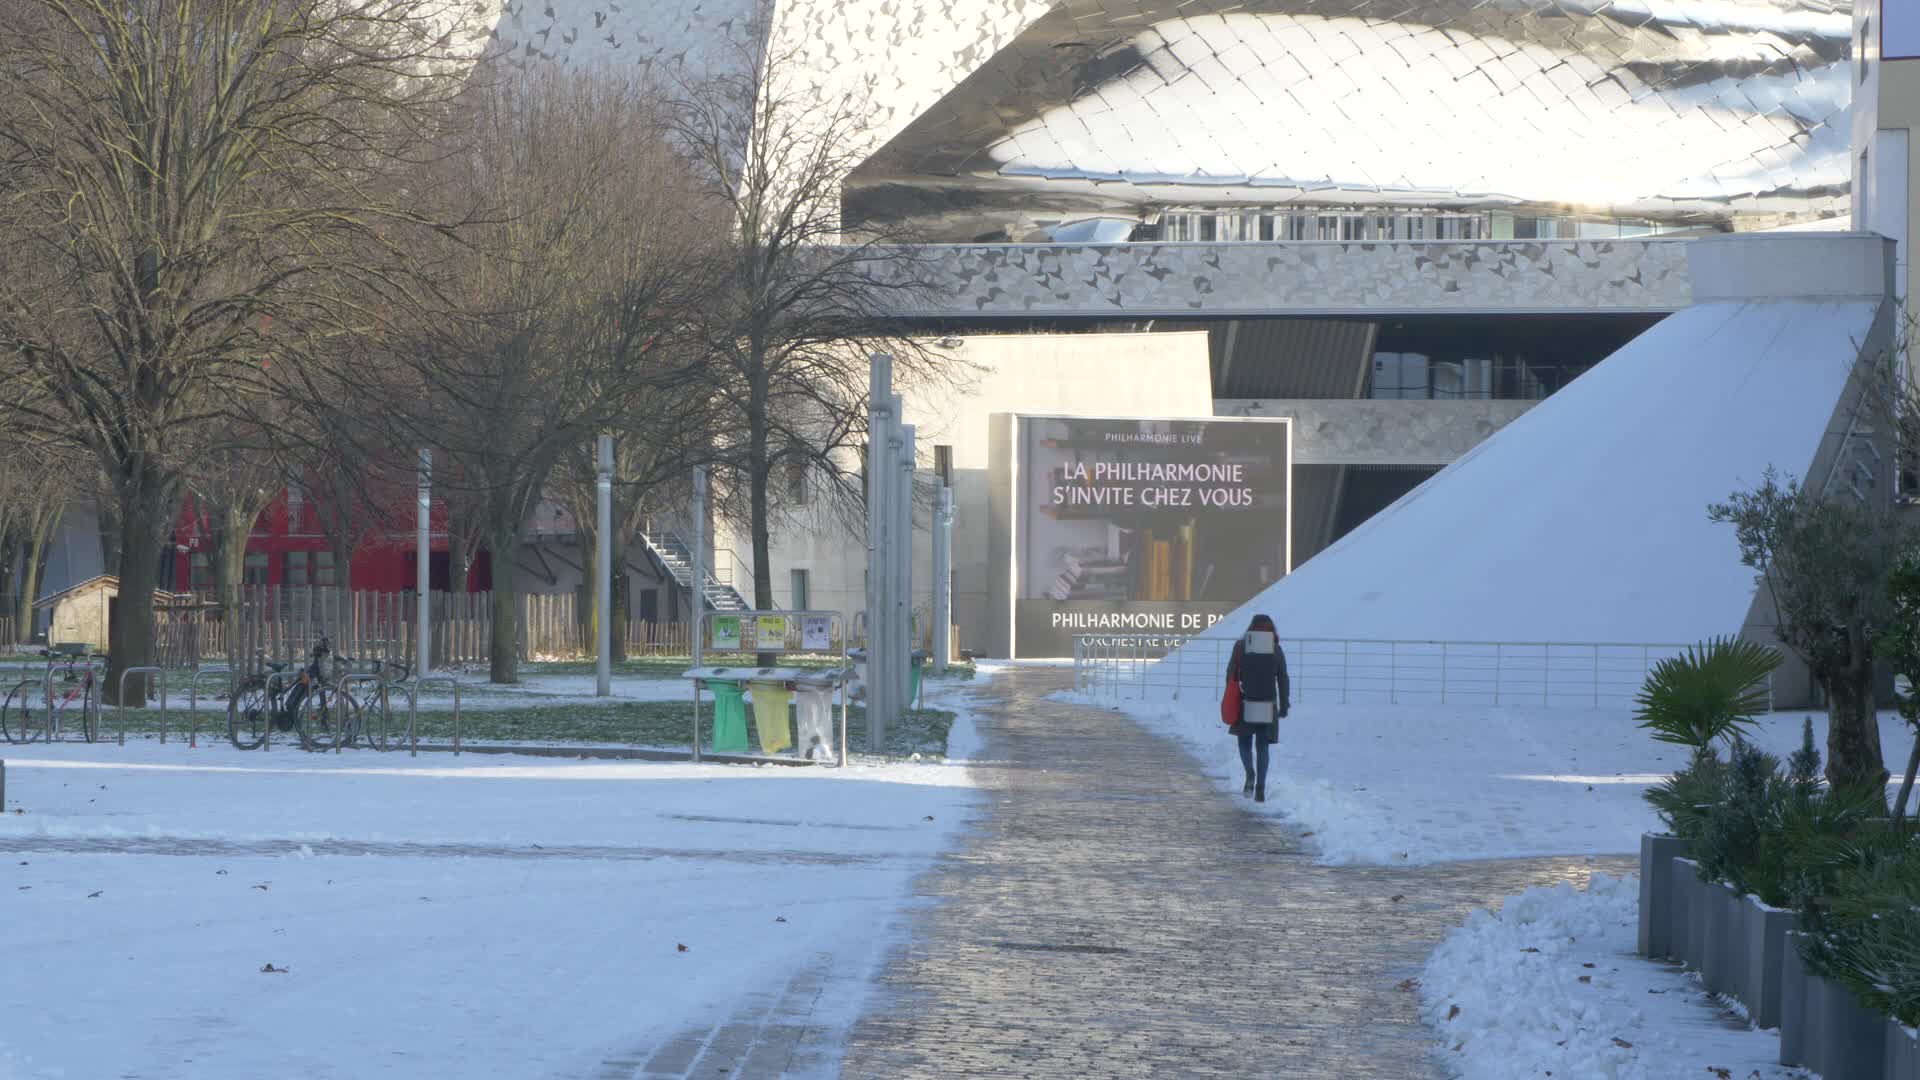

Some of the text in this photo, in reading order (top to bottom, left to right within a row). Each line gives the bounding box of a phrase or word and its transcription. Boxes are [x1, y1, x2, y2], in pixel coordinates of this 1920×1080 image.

[1105, 433, 1202, 444] PHILHARMONIE LIVE
[1064, 462, 1243, 482] LA PHILHARMONIE
[1053, 486, 1253, 506] S'INVITE CHEZ VOUS
[1052, 613, 1175, 628] PHILHARMONIE
[1181, 614, 1201, 629] DE
